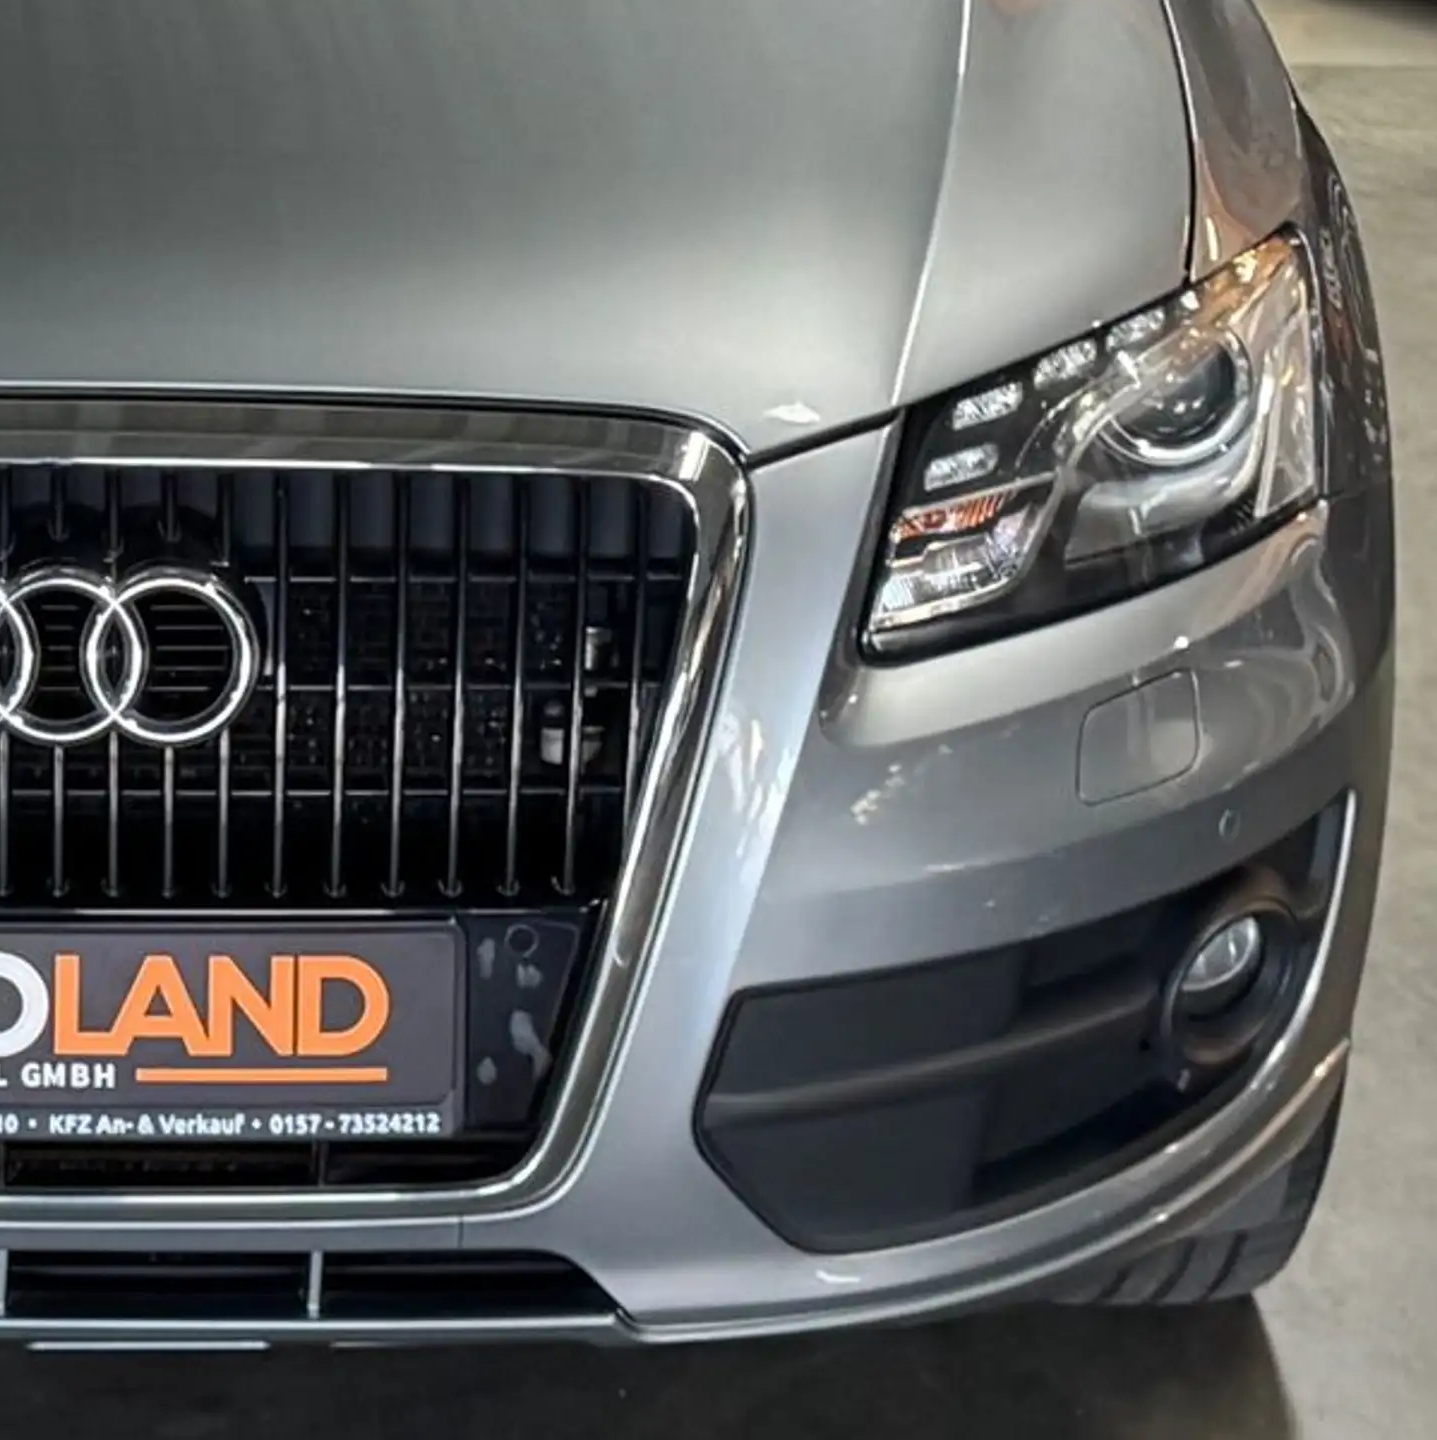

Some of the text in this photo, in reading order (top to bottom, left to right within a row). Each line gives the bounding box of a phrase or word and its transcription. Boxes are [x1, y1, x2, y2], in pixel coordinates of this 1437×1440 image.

[20, 1061, 117, 1089] GMBH
[49, 1113, 92, 1135] KFZ
[95, 1113, 135, 1135] An-
[137, 1114, 155, 1135] &
[158, 1112, 246, 1136] Verkauf
[337, 1112, 441, 1135] 73524212
